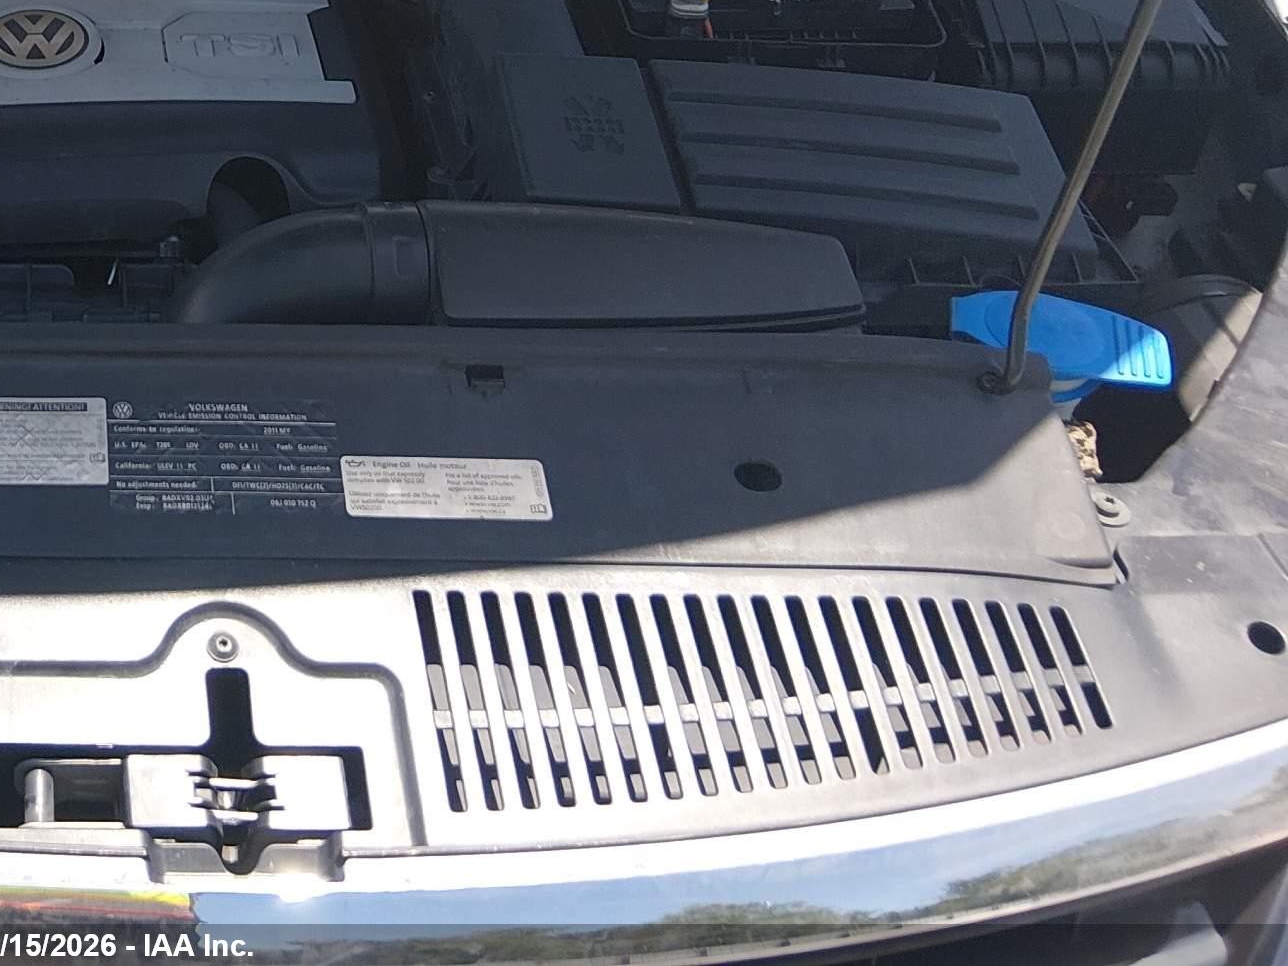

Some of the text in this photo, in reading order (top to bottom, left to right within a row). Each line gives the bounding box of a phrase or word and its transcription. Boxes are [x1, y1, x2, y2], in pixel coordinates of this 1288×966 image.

[180, 34, 302, 58] TSI
[188, 403, 248, 412] VOLKSWAGEN
[259, 413, 307, 421] INFORMATION
[372, 460, 398, 468] Engine
[128, 481, 169, 489] adjustments
